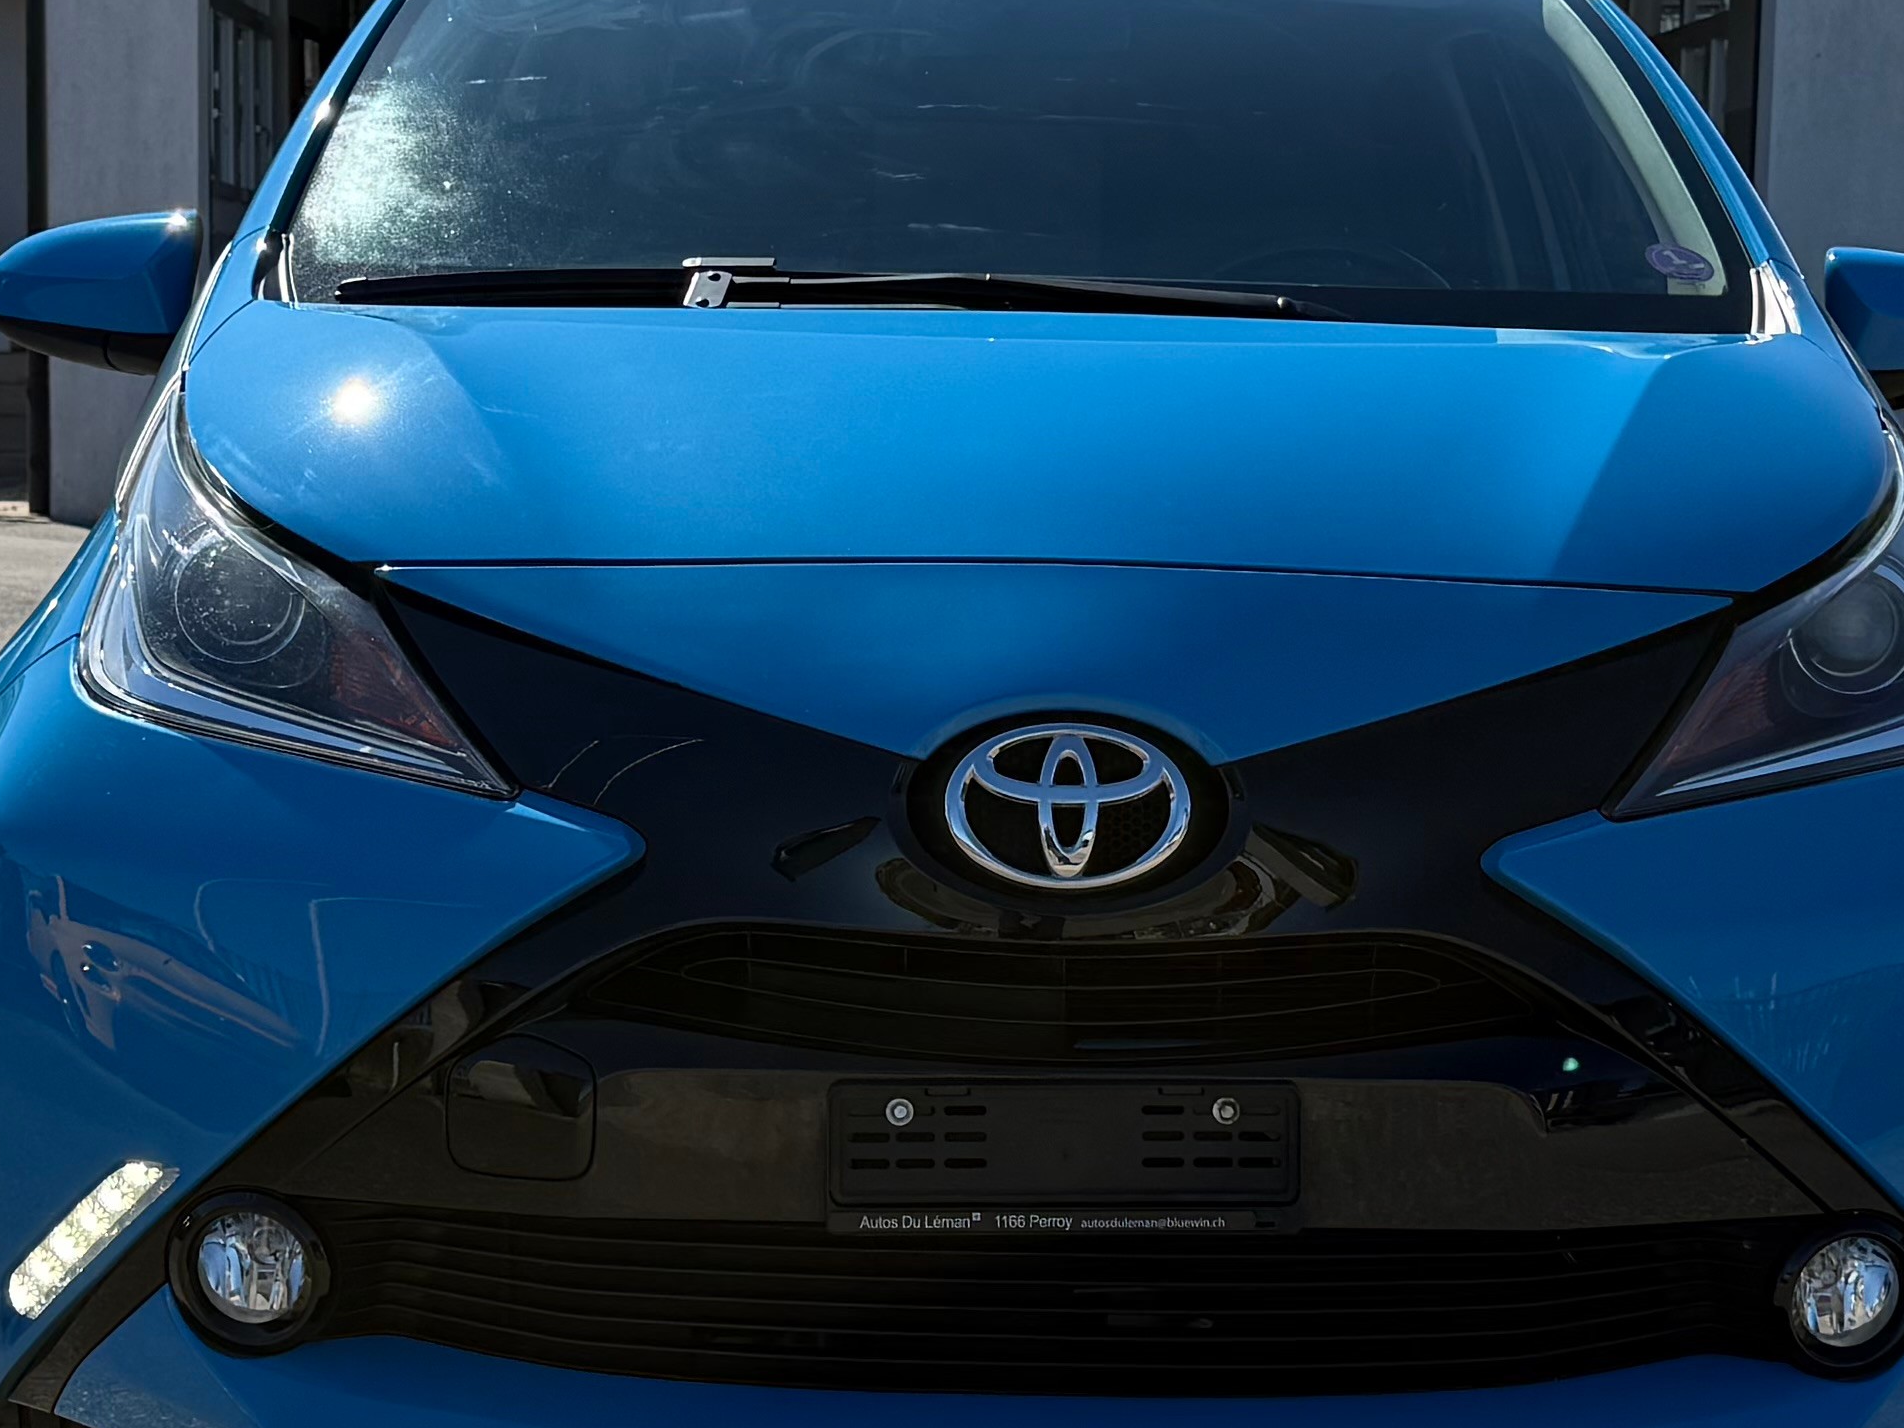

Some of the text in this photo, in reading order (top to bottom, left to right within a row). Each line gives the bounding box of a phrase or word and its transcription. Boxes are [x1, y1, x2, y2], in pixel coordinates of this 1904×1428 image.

[859, 1215, 899, 1229] Autos
[901, 1215, 921, 1229] Du
[924, 1214, 971, 1229] Léman
[995, 1214, 1026, 1228] 1166
[1029, 1214, 1073, 1230] Perroy
